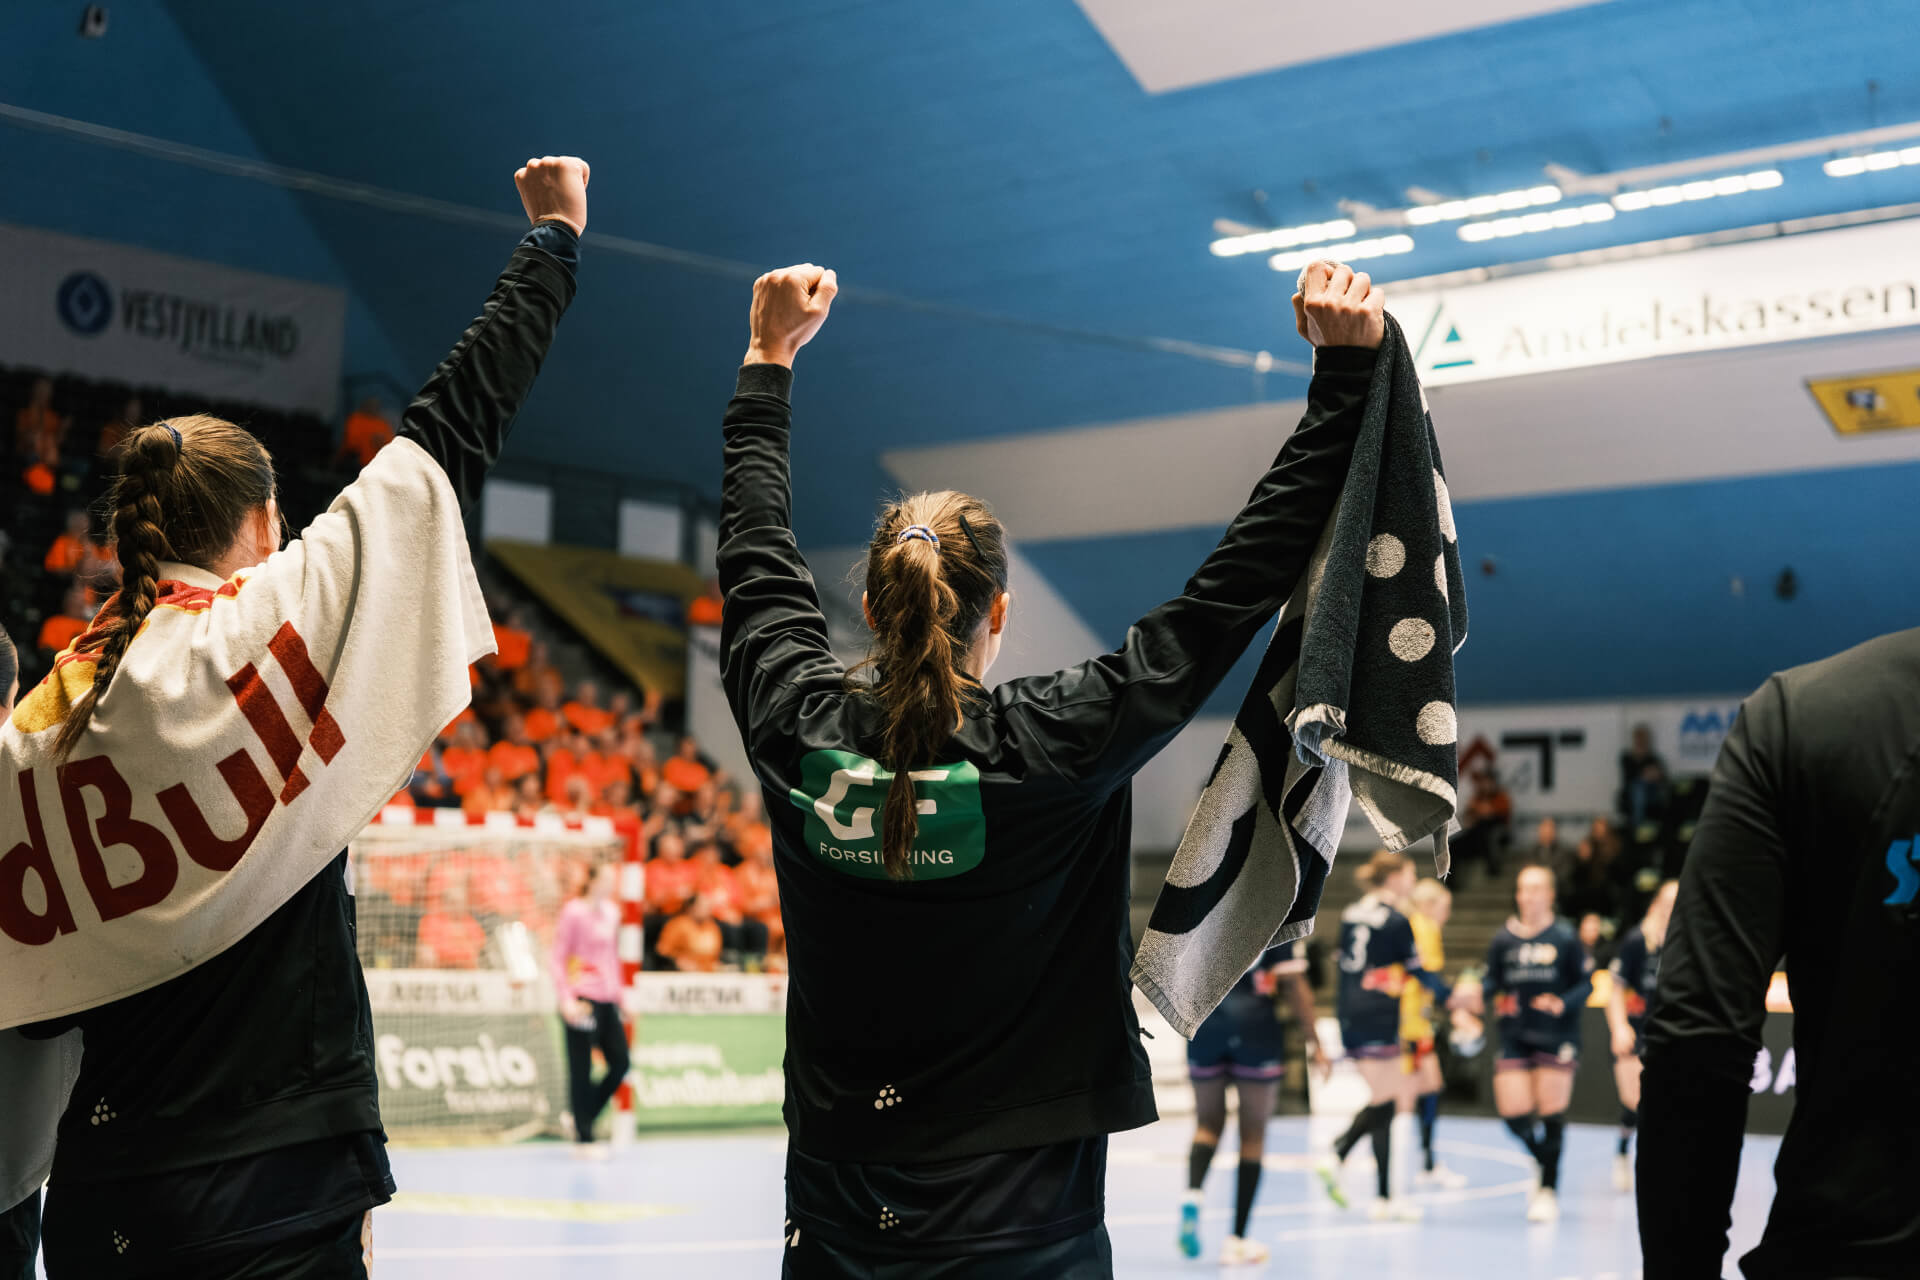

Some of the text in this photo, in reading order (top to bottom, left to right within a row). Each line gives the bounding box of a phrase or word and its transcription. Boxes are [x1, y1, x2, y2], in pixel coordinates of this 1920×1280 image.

[121, 289, 298, 358] VESTJYLLAND
[1497, 280, 1918, 360] Andelskassen
[820, 841, 954, 865] FORSIING
